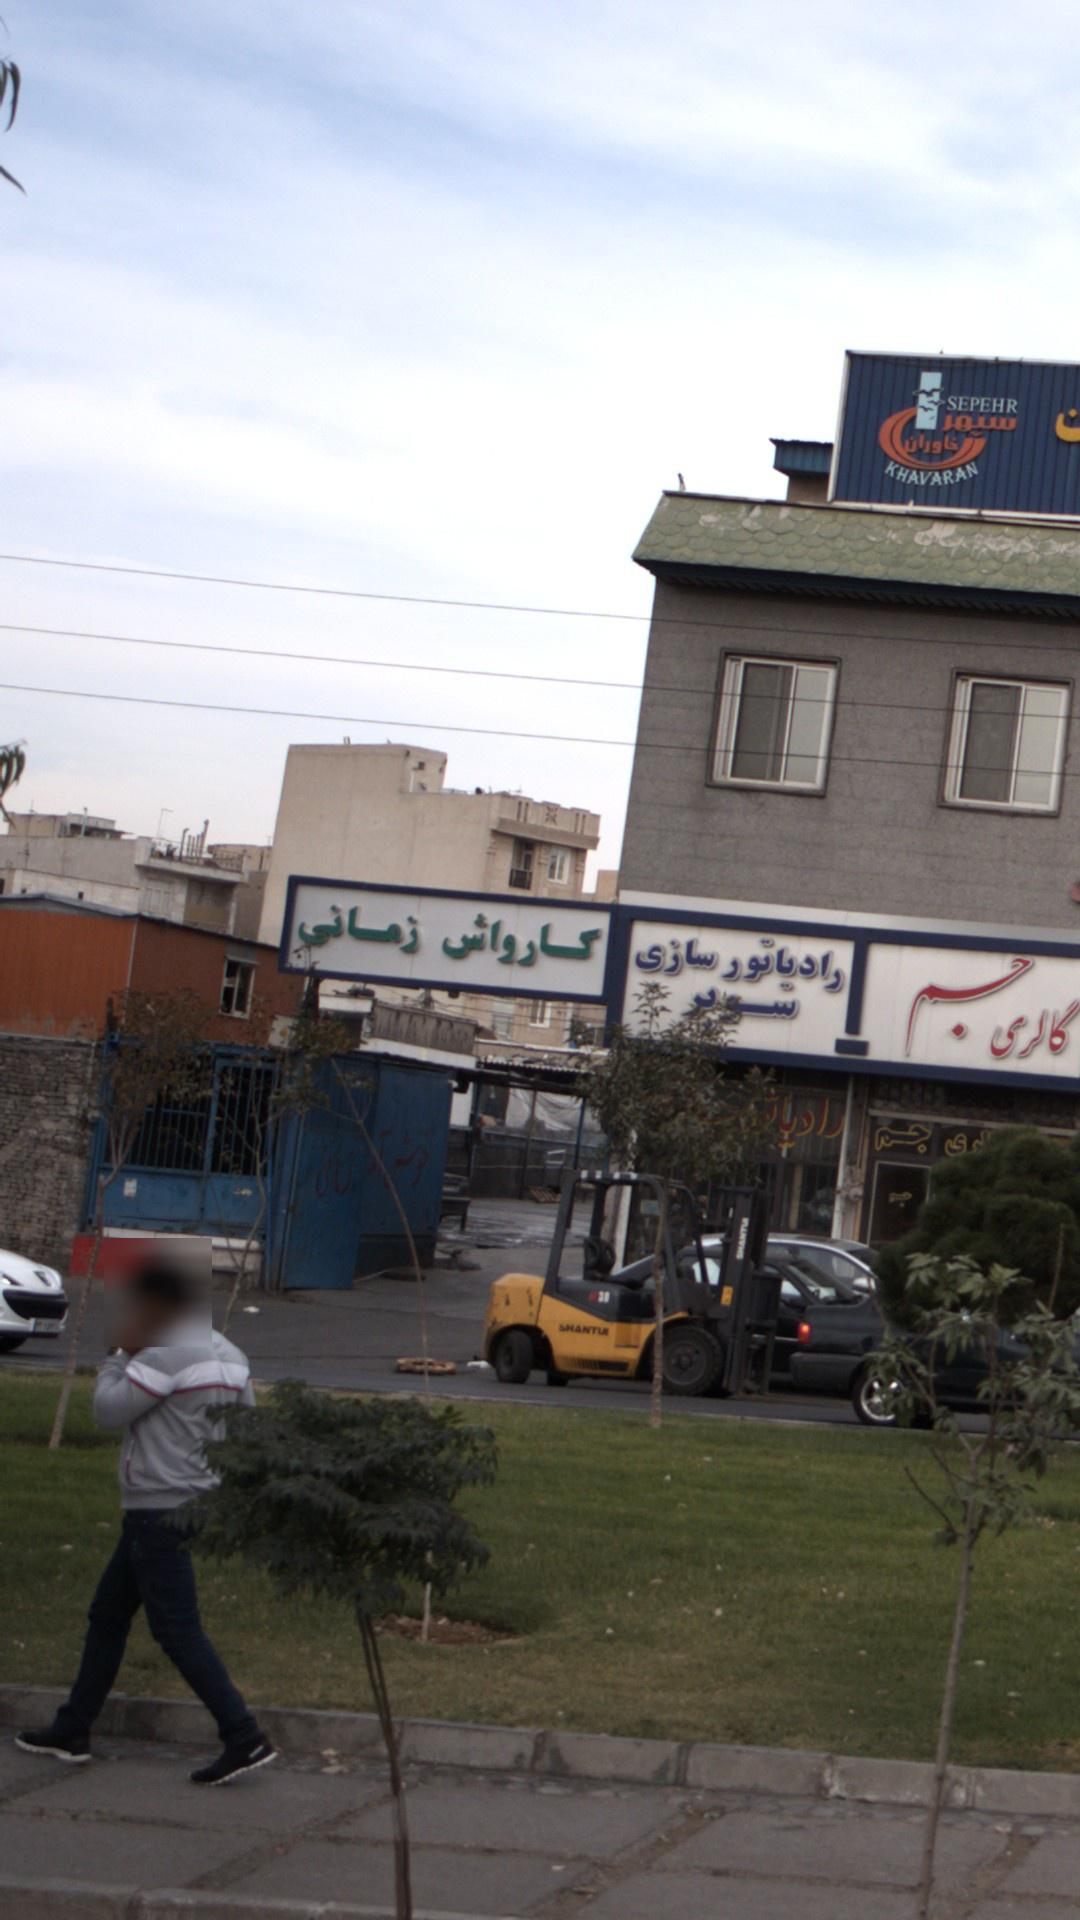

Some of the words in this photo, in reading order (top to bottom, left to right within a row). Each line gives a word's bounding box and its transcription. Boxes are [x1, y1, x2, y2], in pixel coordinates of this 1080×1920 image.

[947, 396, 1018, 414] SEPEHR
[904, 432, 958, 455] خاوران
[885, 460, 979, 487] KHAVARAN
[299, 904, 419, 953] زمانی
[441, 912, 603, 967] کارواش
[635, 938, 718, 974] سازی
[721, 937, 846, 992] رادیاتور
[905, 956, 1034, 1057] جم
[990, 1000, 1080, 1059] گالری
